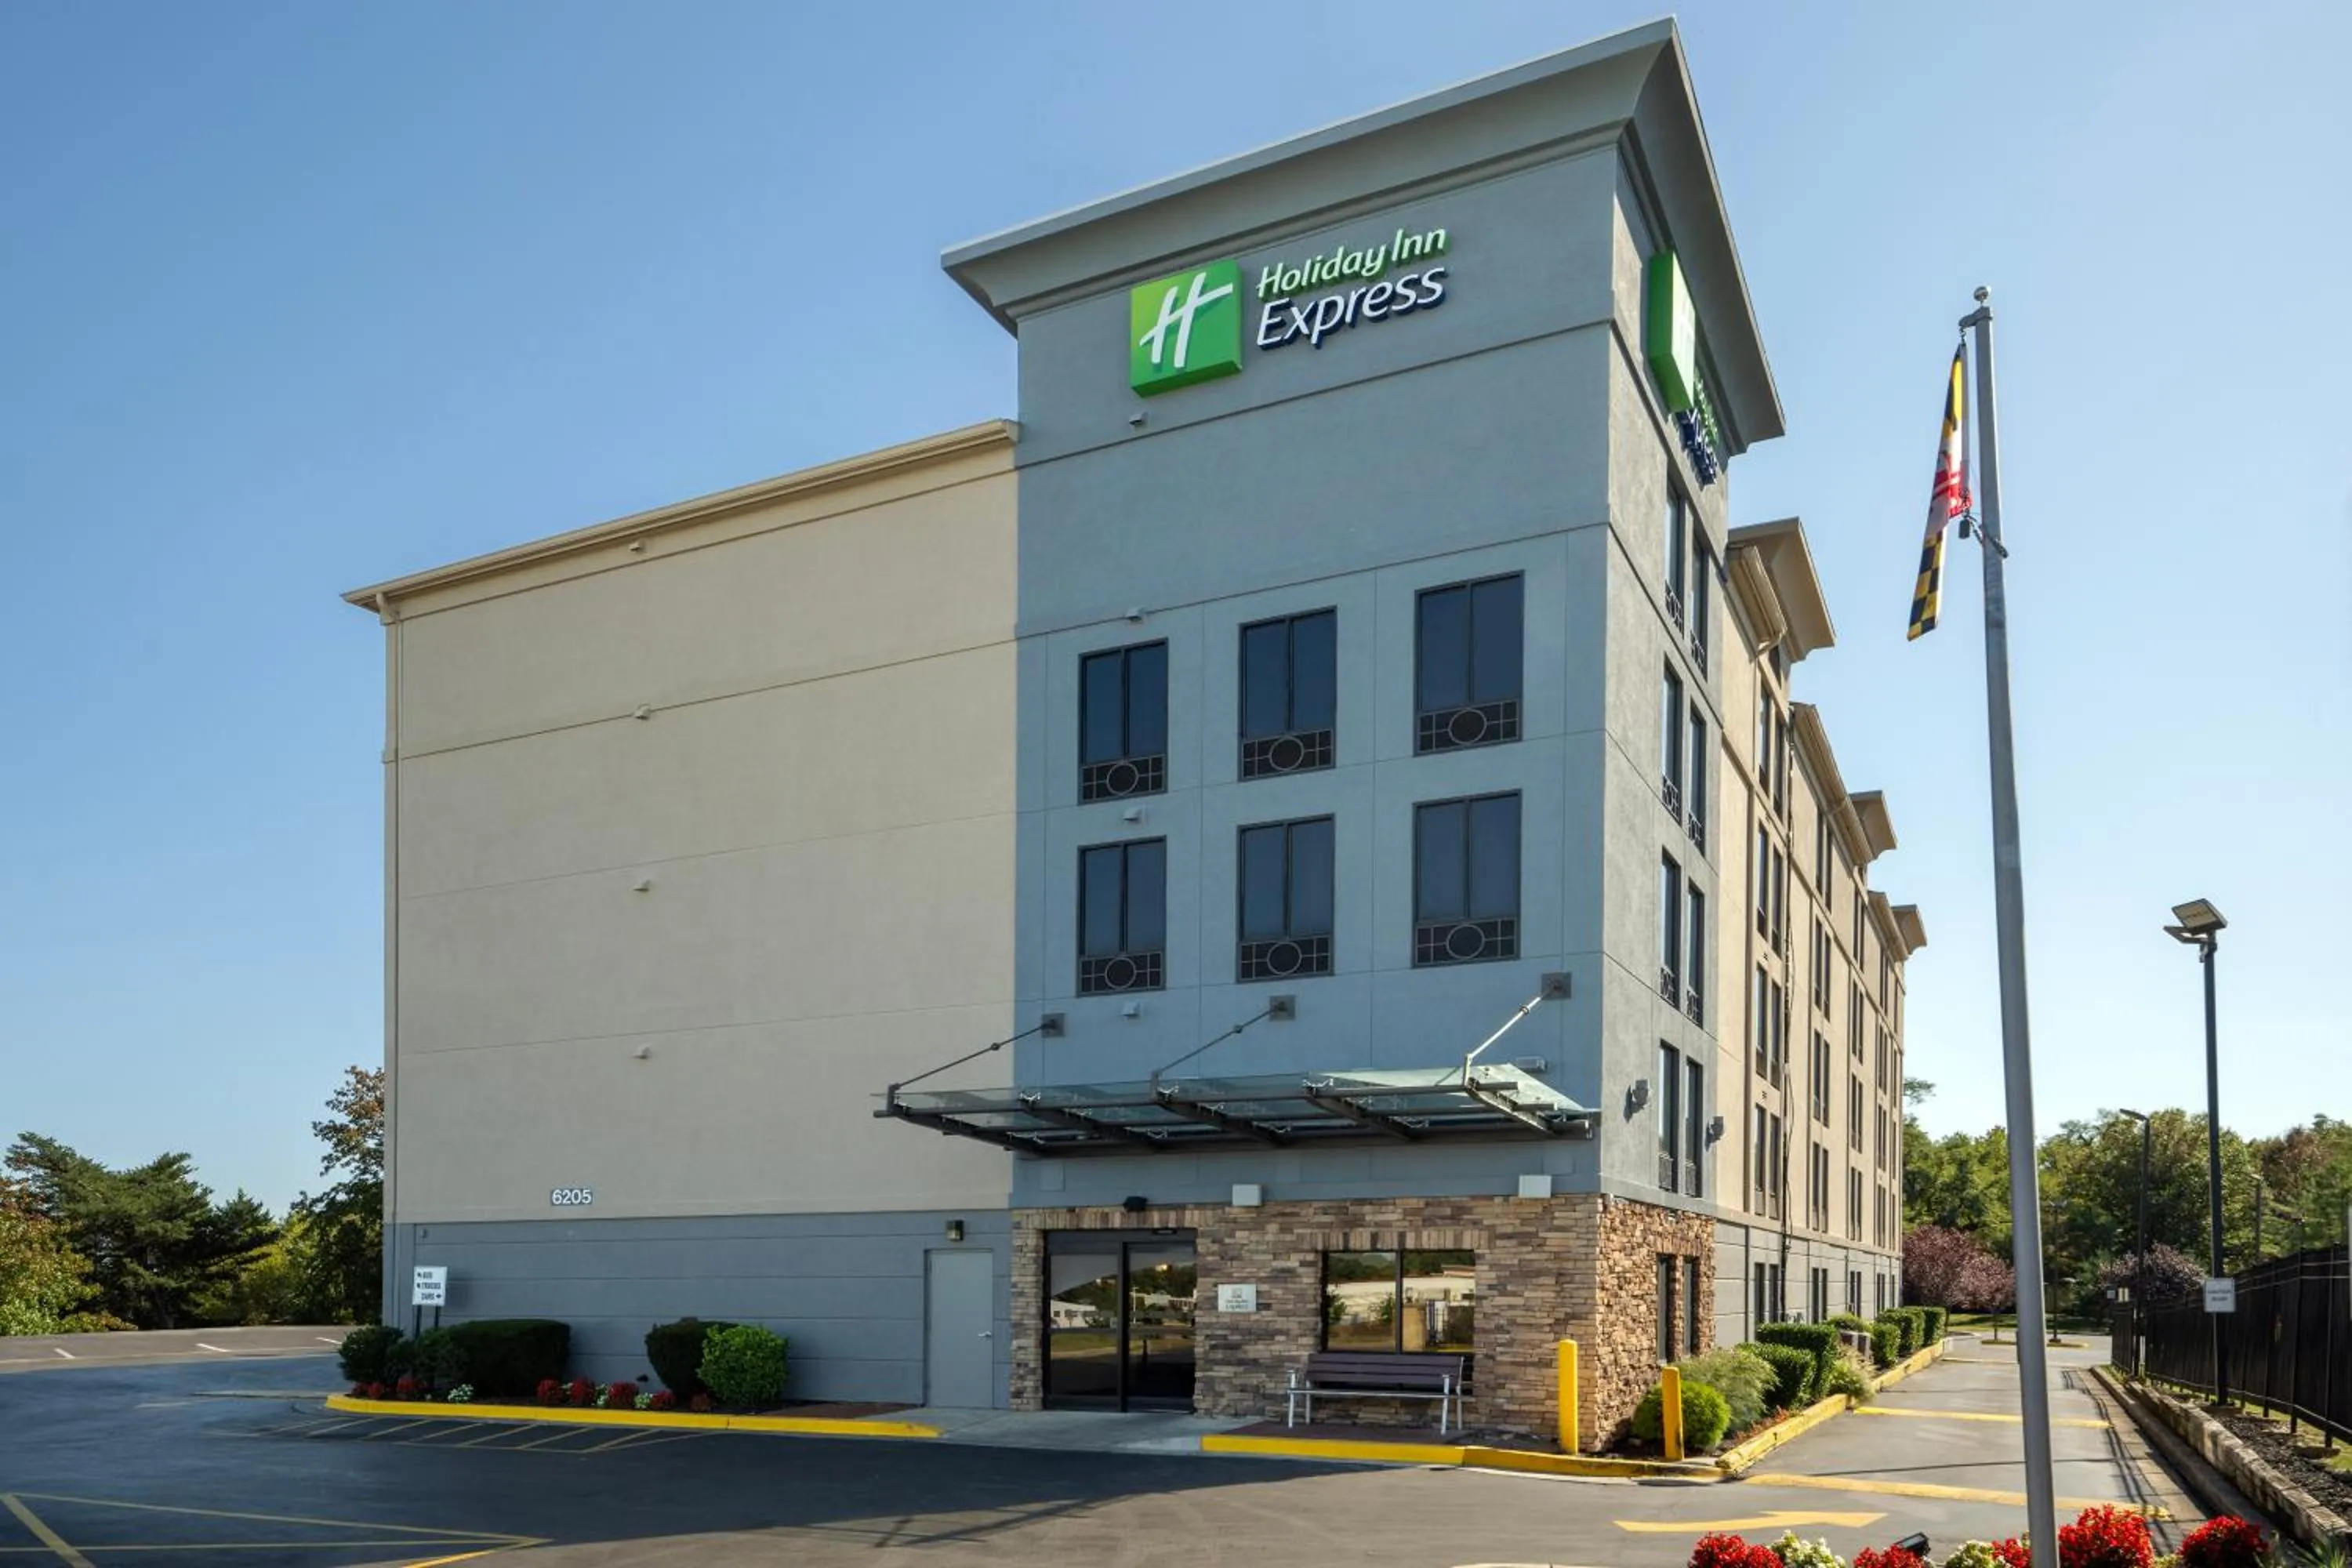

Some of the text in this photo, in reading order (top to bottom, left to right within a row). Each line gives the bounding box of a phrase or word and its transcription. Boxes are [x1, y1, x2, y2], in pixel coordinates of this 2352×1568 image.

[1257, 228, 1448, 299] Holiday Inn
[1257, 267, 1447, 347] Express
[552, 1189, 592, 1205] 6205
